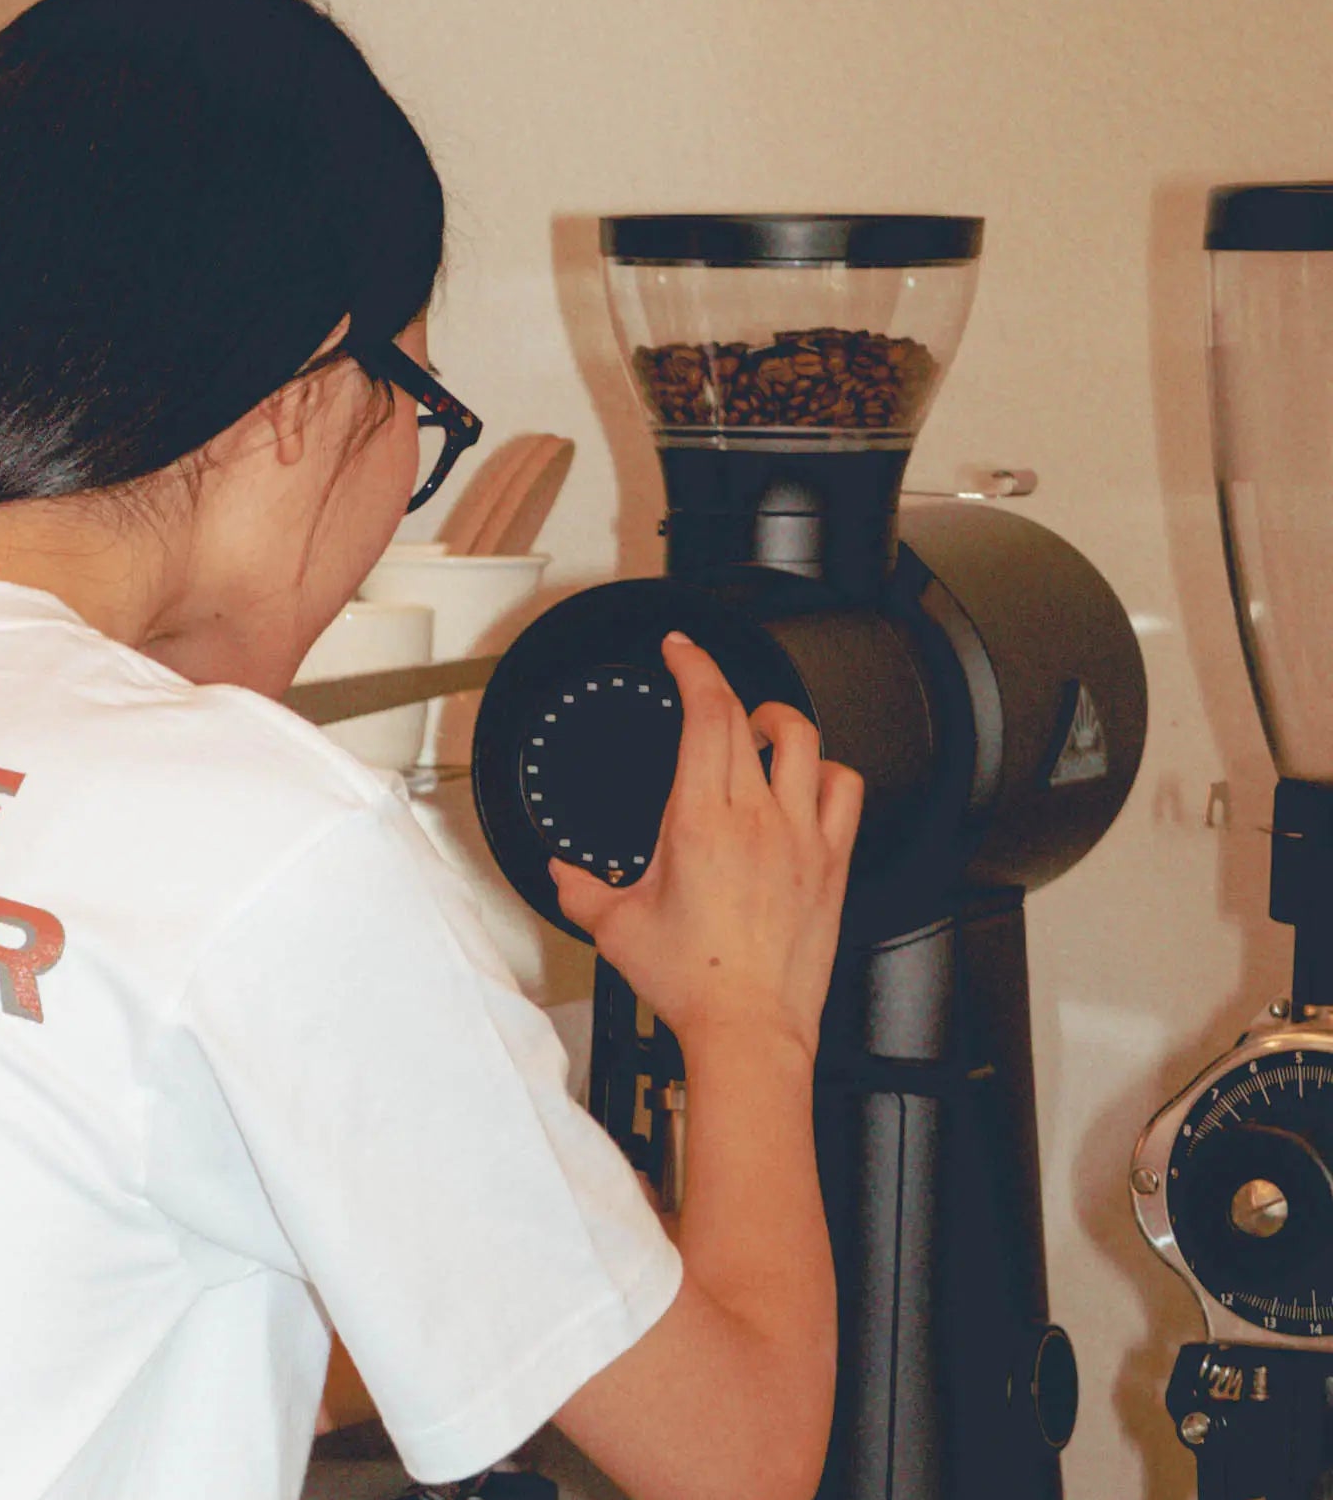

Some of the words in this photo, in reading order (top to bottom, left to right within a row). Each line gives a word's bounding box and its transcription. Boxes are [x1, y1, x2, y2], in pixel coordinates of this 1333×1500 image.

[1295, 1051, 1304, 1064] 5
[1211, 1088, 1220, 1100] 7
[1264, 1316, 1276, 1329] 13
[1309, 1323, 1322, 1335] 14
